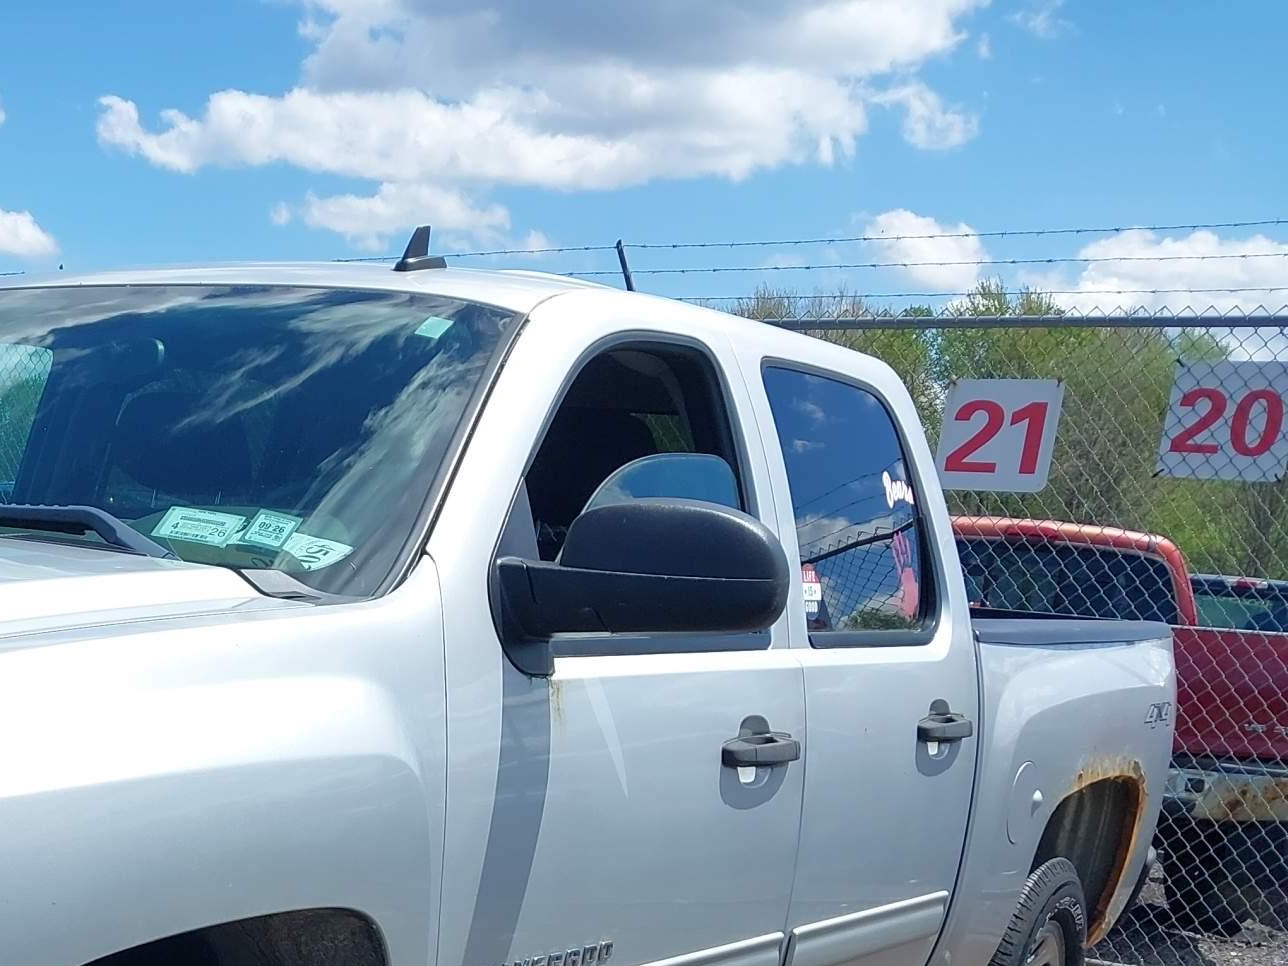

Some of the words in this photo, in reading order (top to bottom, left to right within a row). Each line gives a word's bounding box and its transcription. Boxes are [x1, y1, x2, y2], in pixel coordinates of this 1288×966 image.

[943, 399, 1049, 475] 21
[1168, 387, 1285, 458] 20
[208, 527, 228, 538] 26
